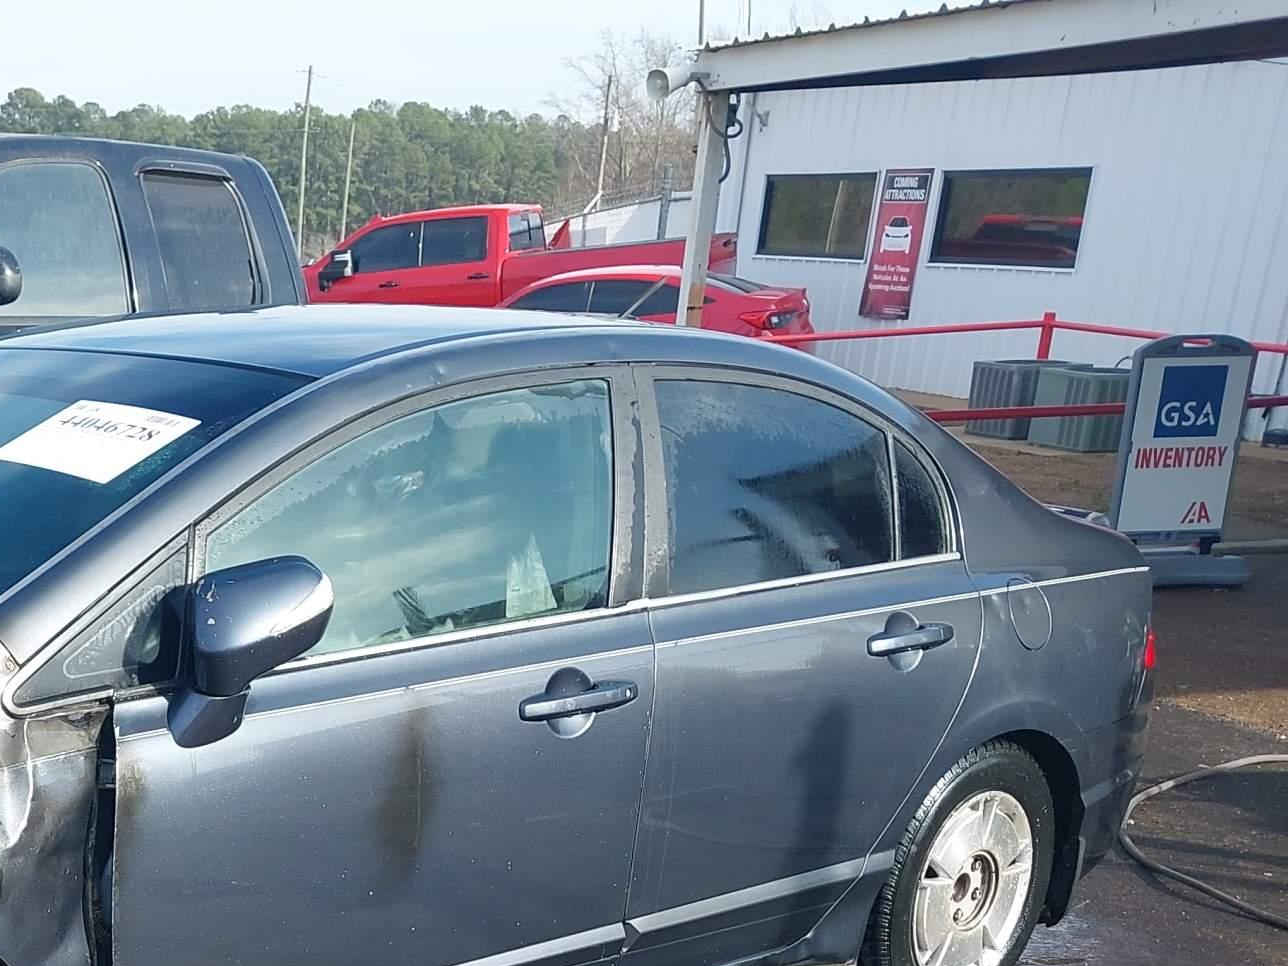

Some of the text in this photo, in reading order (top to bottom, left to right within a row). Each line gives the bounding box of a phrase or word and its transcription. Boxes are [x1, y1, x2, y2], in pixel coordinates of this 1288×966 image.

[894, 176, 918, 188] COMING
[885, 189, 926, 201] ATTRACTIONS
[1161, 401, 1215, 427] GSA
[59, 415, 160, 442] 44046728
[1135, 446, 1228, 469] INVENTORY
